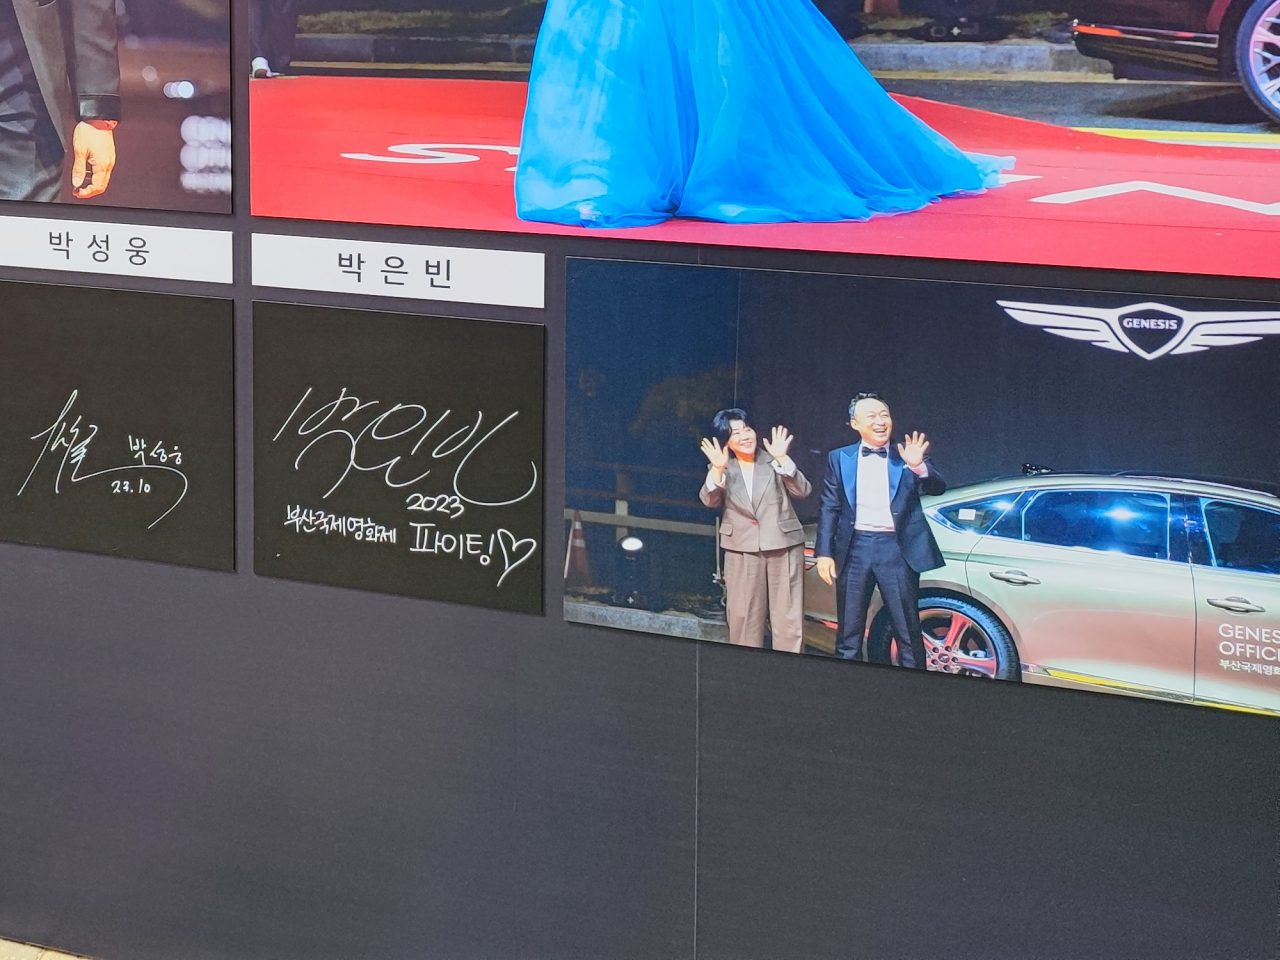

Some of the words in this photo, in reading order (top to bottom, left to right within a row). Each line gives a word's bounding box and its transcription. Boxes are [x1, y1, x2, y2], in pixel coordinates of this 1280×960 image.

[48, 230, 150, 267] 박성웅
[336, 252, 453, 290] 박은빈
[1122, 317, 1178, 330] GENESIS
[283, 504, 397, 544] 부산국제영화제
[406, 492, 465, 519] 2023
